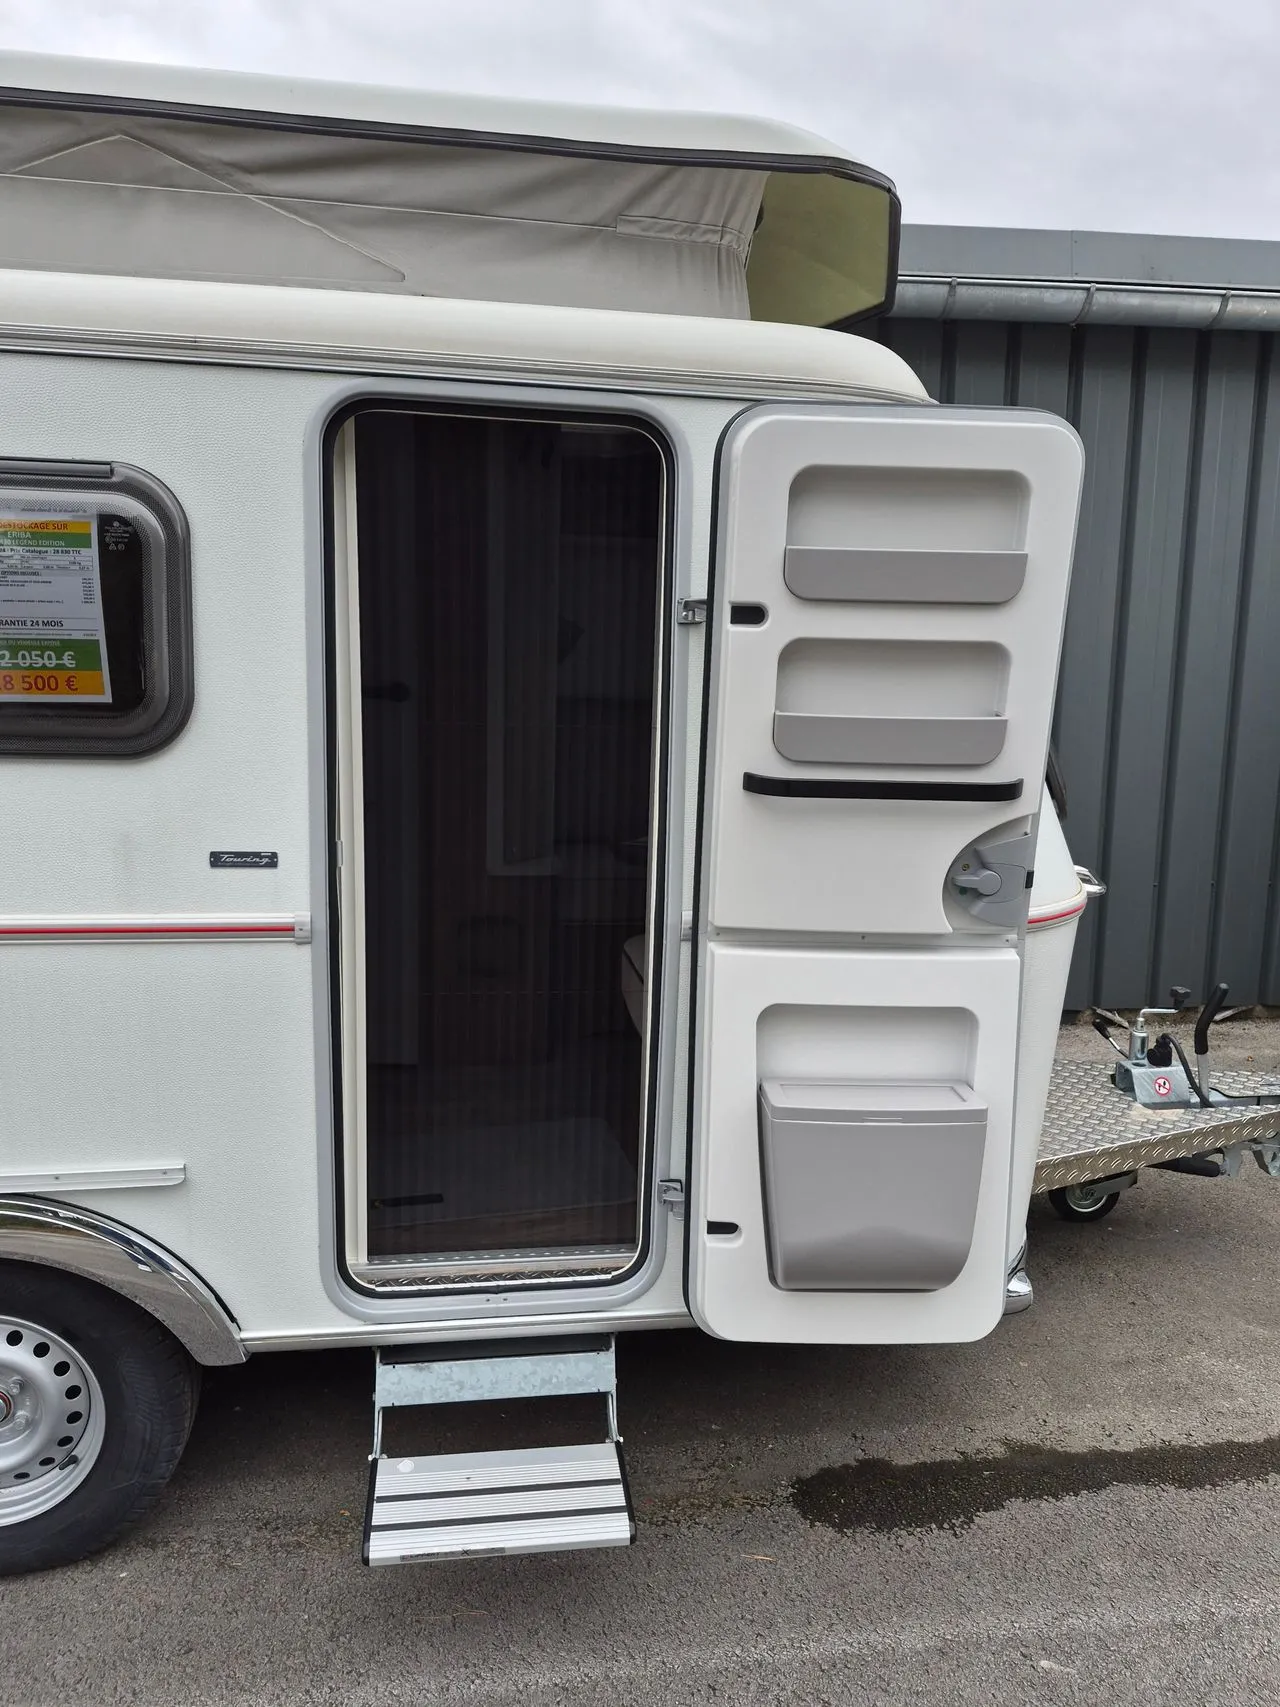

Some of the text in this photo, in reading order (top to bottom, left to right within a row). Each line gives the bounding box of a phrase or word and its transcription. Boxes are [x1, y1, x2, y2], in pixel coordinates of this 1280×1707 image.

[7, 531, 31, 539] ERIBA
[41, 620, 64, 628] MOIS
[18, 650, 56, 668] 050
[62, 651, 76, 668] €
[0, 674, 78, 692] 8 500 €
[219, 853, 272, 866] Touring
